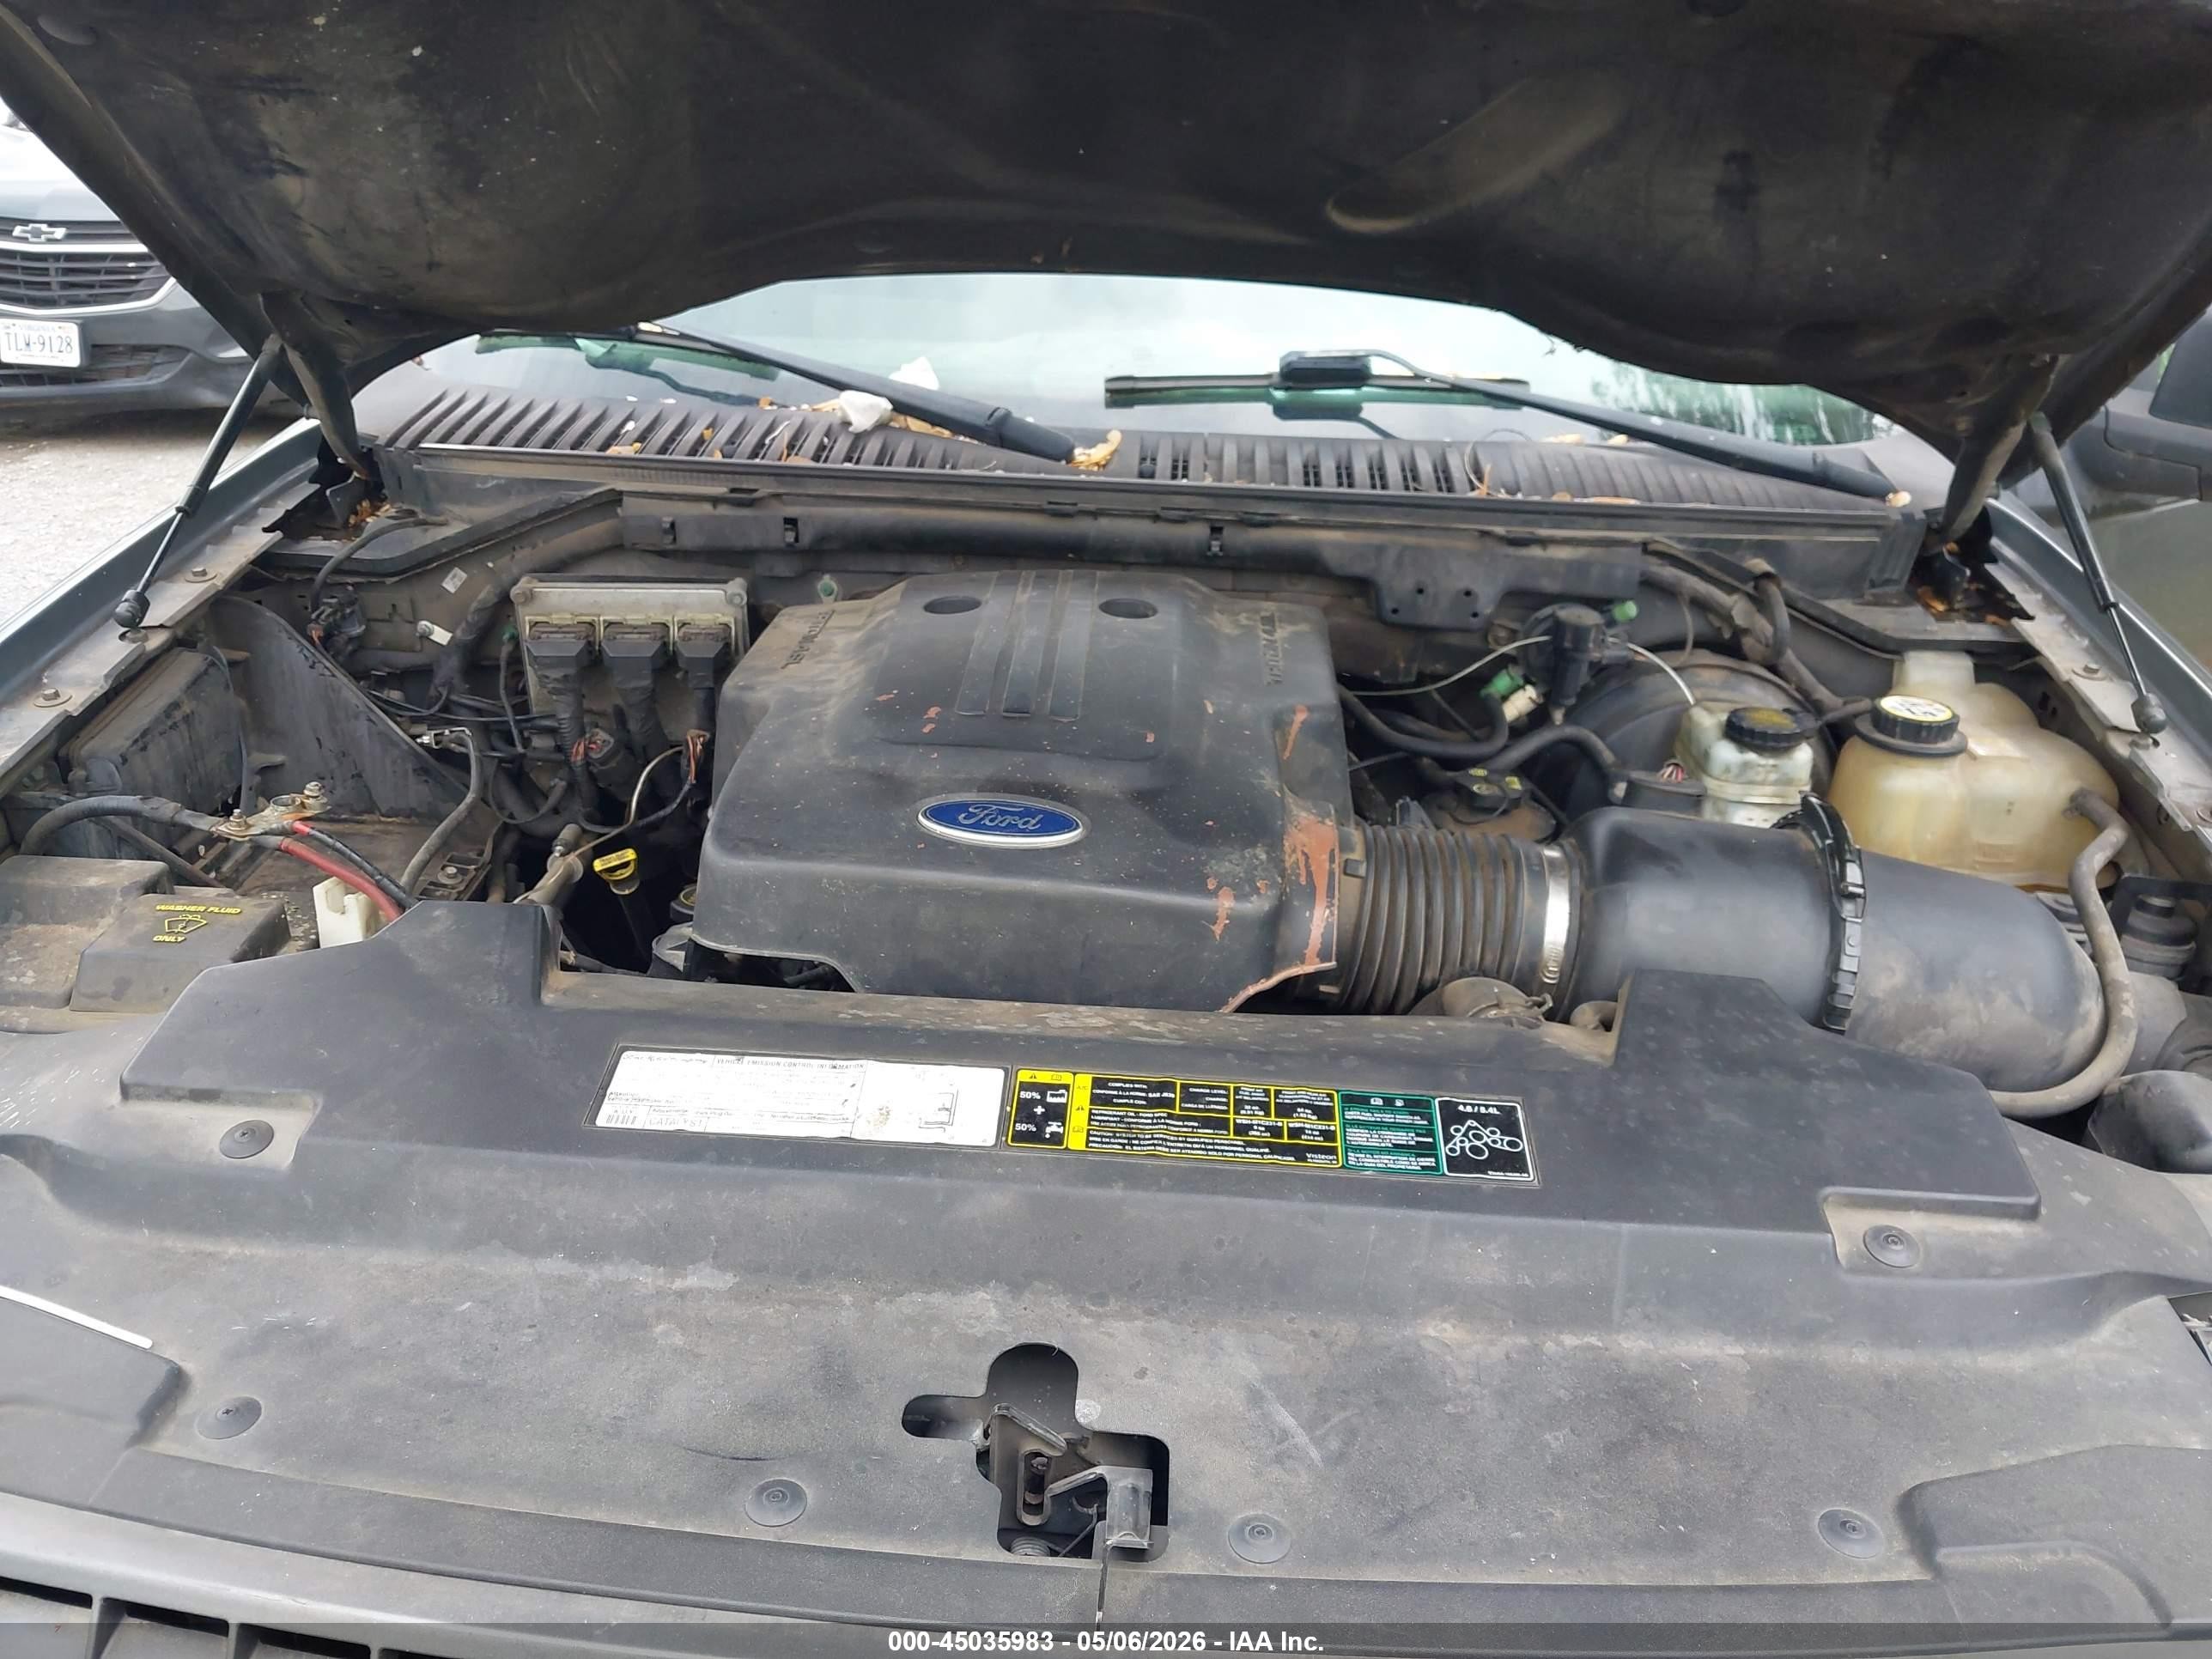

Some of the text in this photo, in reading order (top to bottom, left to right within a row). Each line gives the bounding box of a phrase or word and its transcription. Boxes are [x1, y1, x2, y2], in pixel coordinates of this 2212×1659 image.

[958, 804, 1043, 830] Ford
[207, 906, 242, 915] FLUID
[1019, 1091, 1041, 1099] 50%
[1014, 1122, 1036, 1132] 50%
